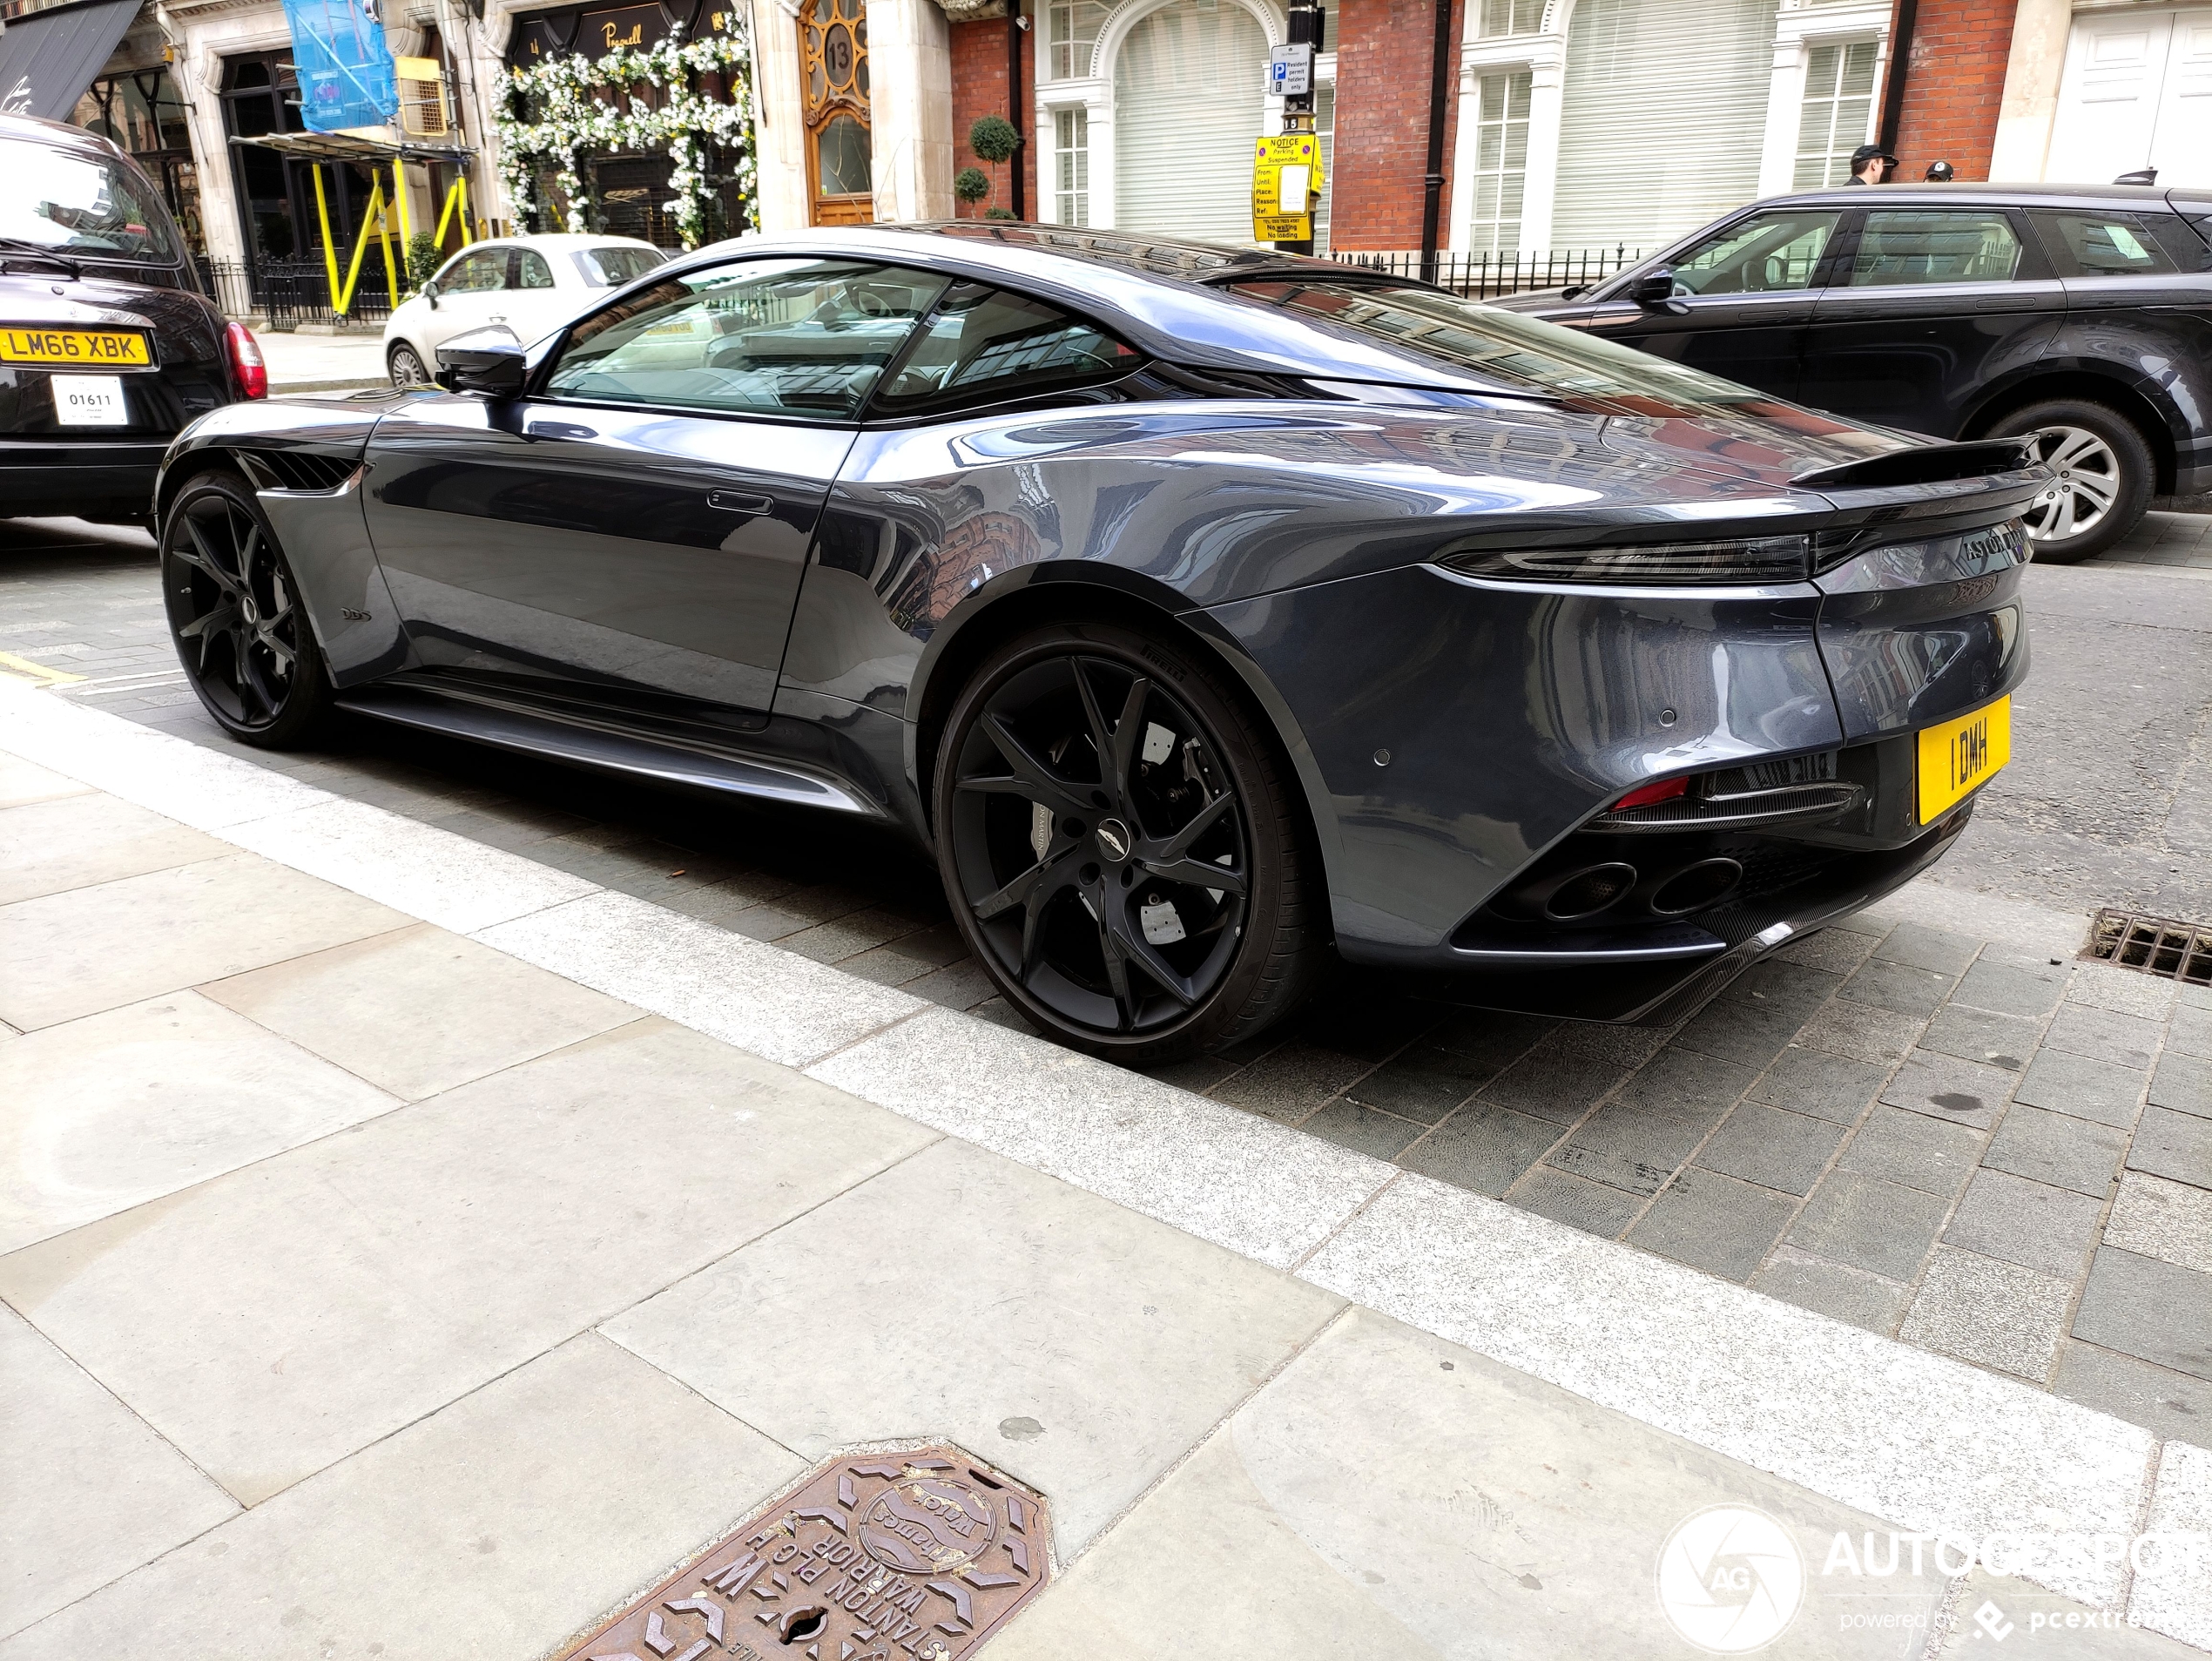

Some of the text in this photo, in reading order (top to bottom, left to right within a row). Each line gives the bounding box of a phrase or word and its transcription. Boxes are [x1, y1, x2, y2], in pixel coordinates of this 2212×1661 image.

[829, 42, 849, 71] 13
[1274, 64, 1285, 80] P
[1271, 138, 1299, 147] NOTICE
[8, 333, 136, 358] LM66 XBK
[69, 394, 111, 406] 01611
[1140, 643, 1188, 683] PIRELLI
[1959, 717, 1987, 786] DMH
[873, 1511, 949, 1562] Thames
[913, 1493, 977, 1538] Water
[773, 1543, 832, 1587] PLC
[813, 1534, 929, 1617] WARRIOR
[824, 1577, 947, 1660] STANTON
